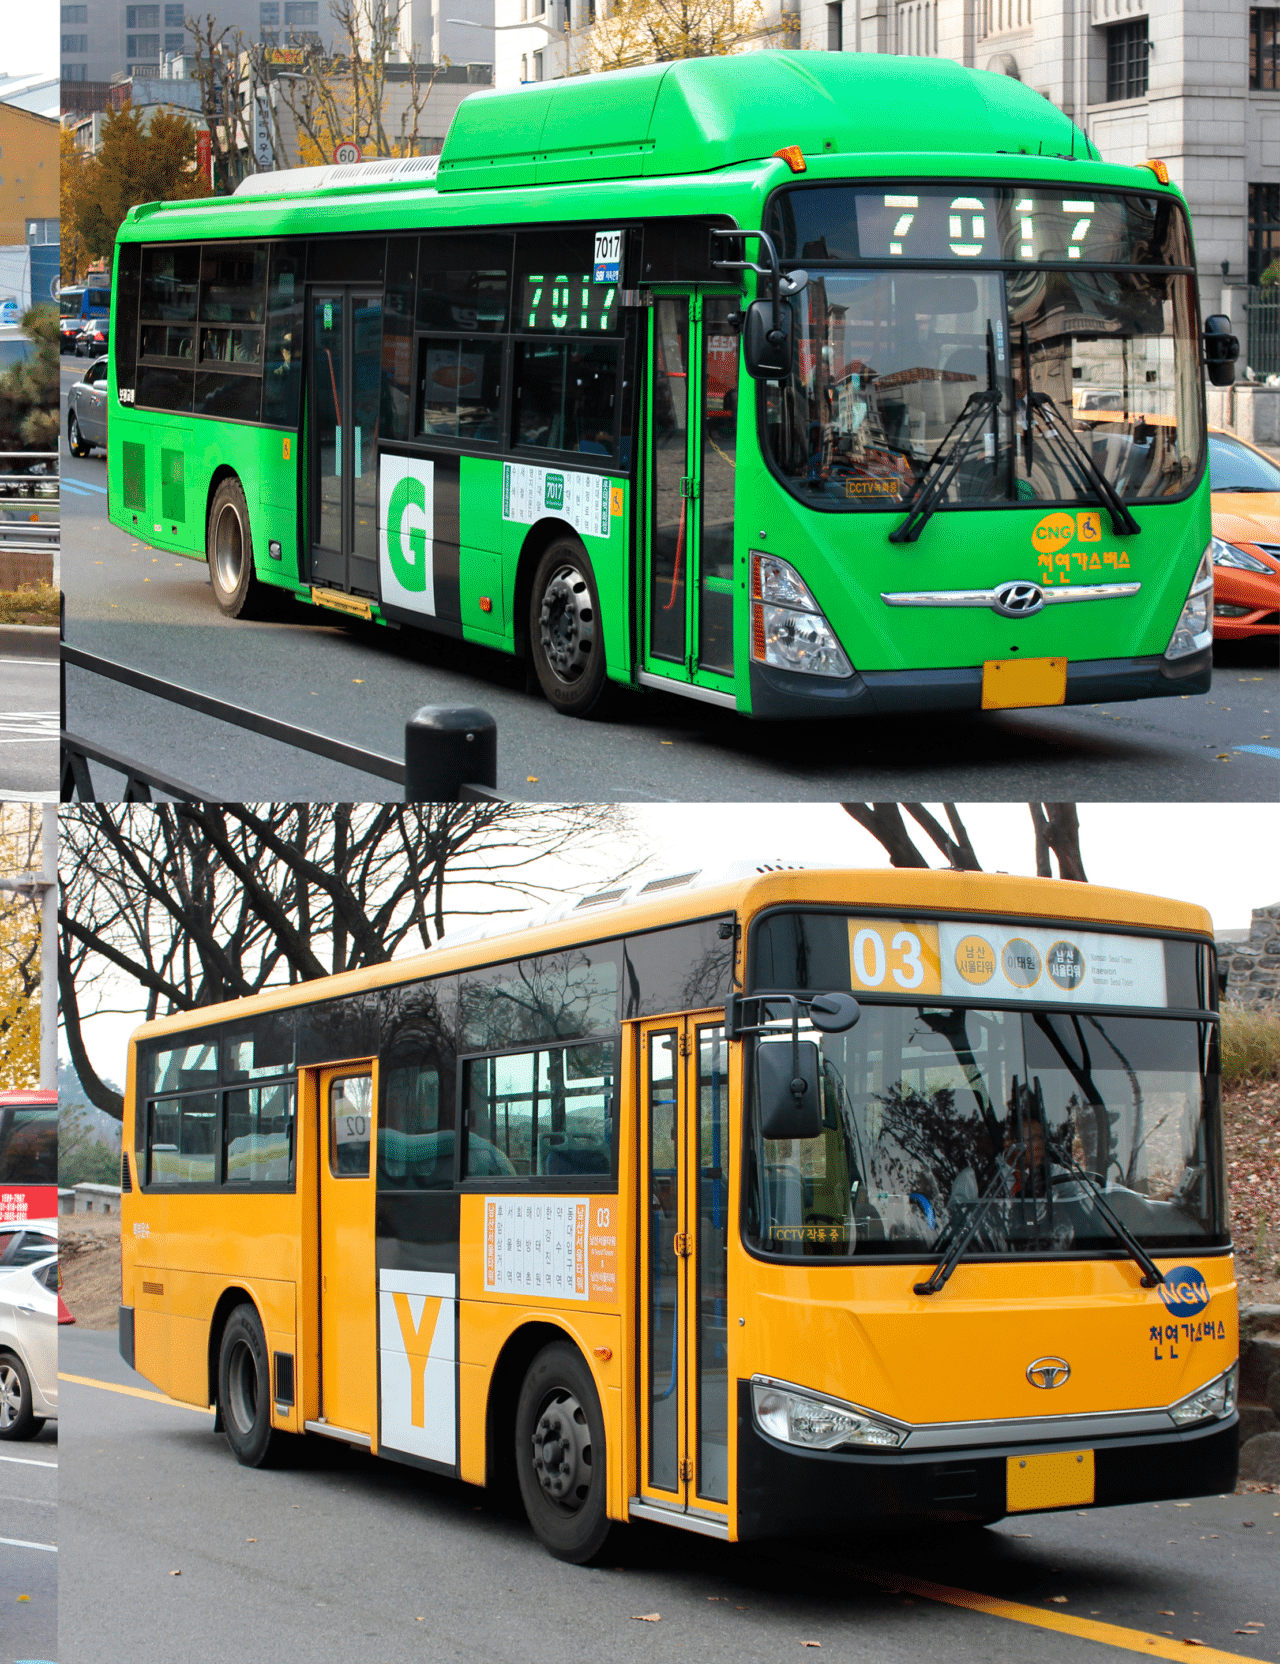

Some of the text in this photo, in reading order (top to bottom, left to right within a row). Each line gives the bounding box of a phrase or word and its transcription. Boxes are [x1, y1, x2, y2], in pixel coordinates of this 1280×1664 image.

[338, 148, 356, 163] 60
[884, 195, 1096, 258] 7017
[596, 236, 620, 258] 7017
[595, 271, 605, 282] SBI
[528, 275, 616, 330] 7017
[546, 482, 563, 500] 7017
[387, 476, 426, 592] G
[1036, 524, 1072, 542] CNG
[1038, 551, 1130, 584] 천연가스버스
[853, 928, 924, 988] 03
[964, 946, 986, 959] 남산
[1056, 950, 1074, 963] 남산
[958, 960, 994, 974] 서울타워
[1008, 956, 1036, 970] 이태원
[1052, 964, 1081, 978] 서울타워
[597, 1208, 610, 1227] 03
[776, 1229, 839, 1242] CCTV 작동 중
[555, 1207, 563, 1288] 약수역
[566, 1207, 574, 1289] 동대입구역
[1160, 1282, 1210, 1306] NGV
[1148, 1322, 1226, 1361] 천연가스버스
[392, 1292, 442, 1428] Y
